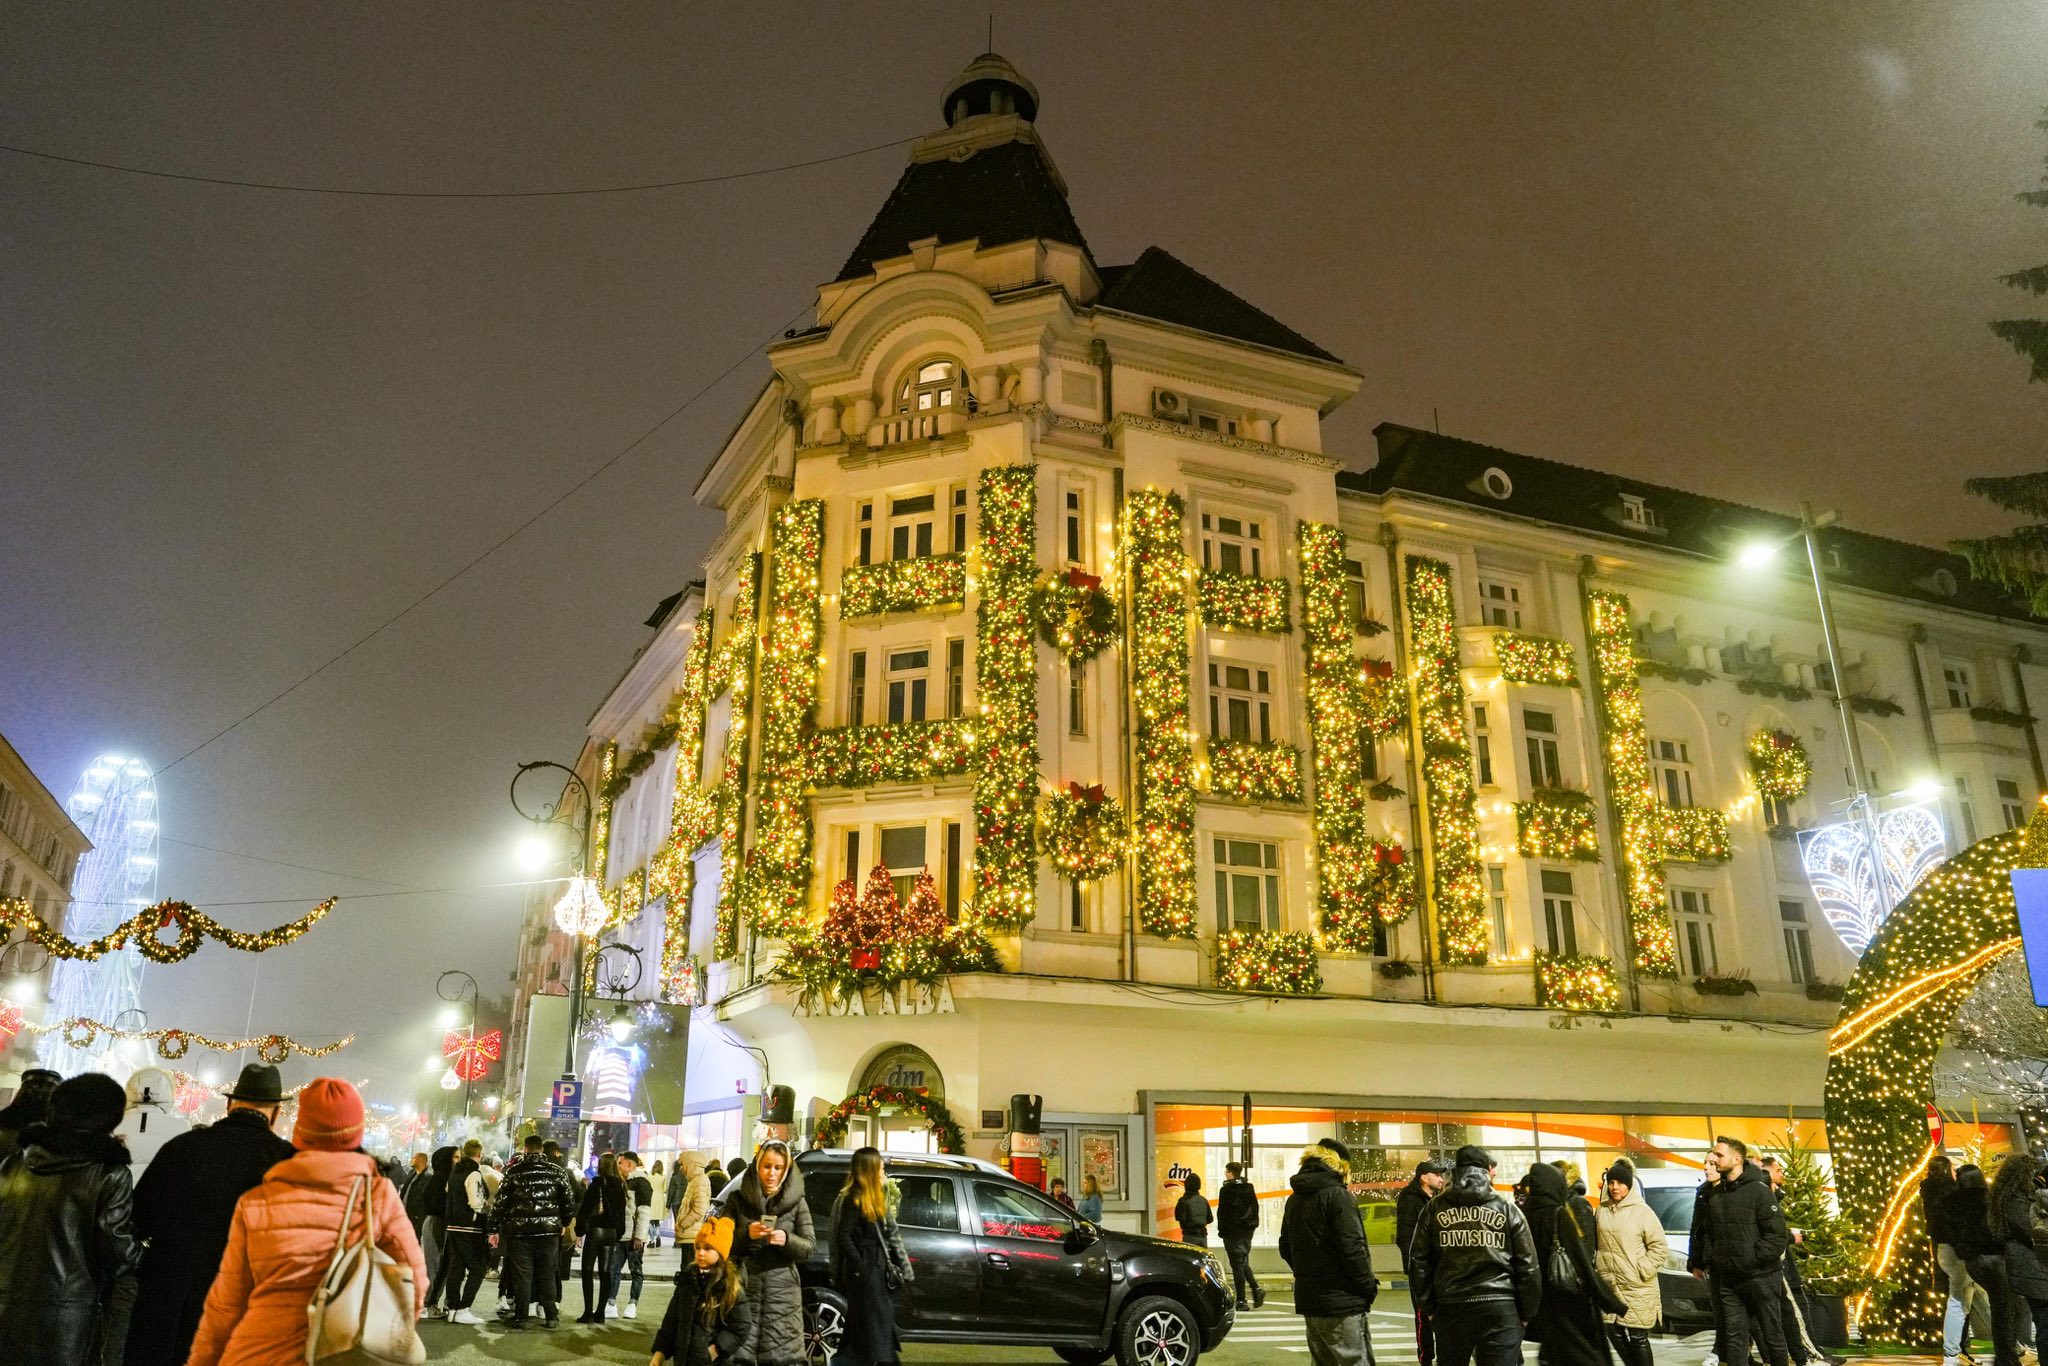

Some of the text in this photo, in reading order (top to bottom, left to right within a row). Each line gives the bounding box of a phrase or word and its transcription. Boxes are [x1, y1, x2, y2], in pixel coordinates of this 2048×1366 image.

[877, 976, 957, 1015] ALBA
[887, 1064, 925, 1087] dm
[558, 1083, 576, 1106] P
[1168, 1163, 1192, 1179] dm
[1437, 1205, 1507, 1230] CHAOTIC
[1439, 1229, 1506, 1249] DIVISION
